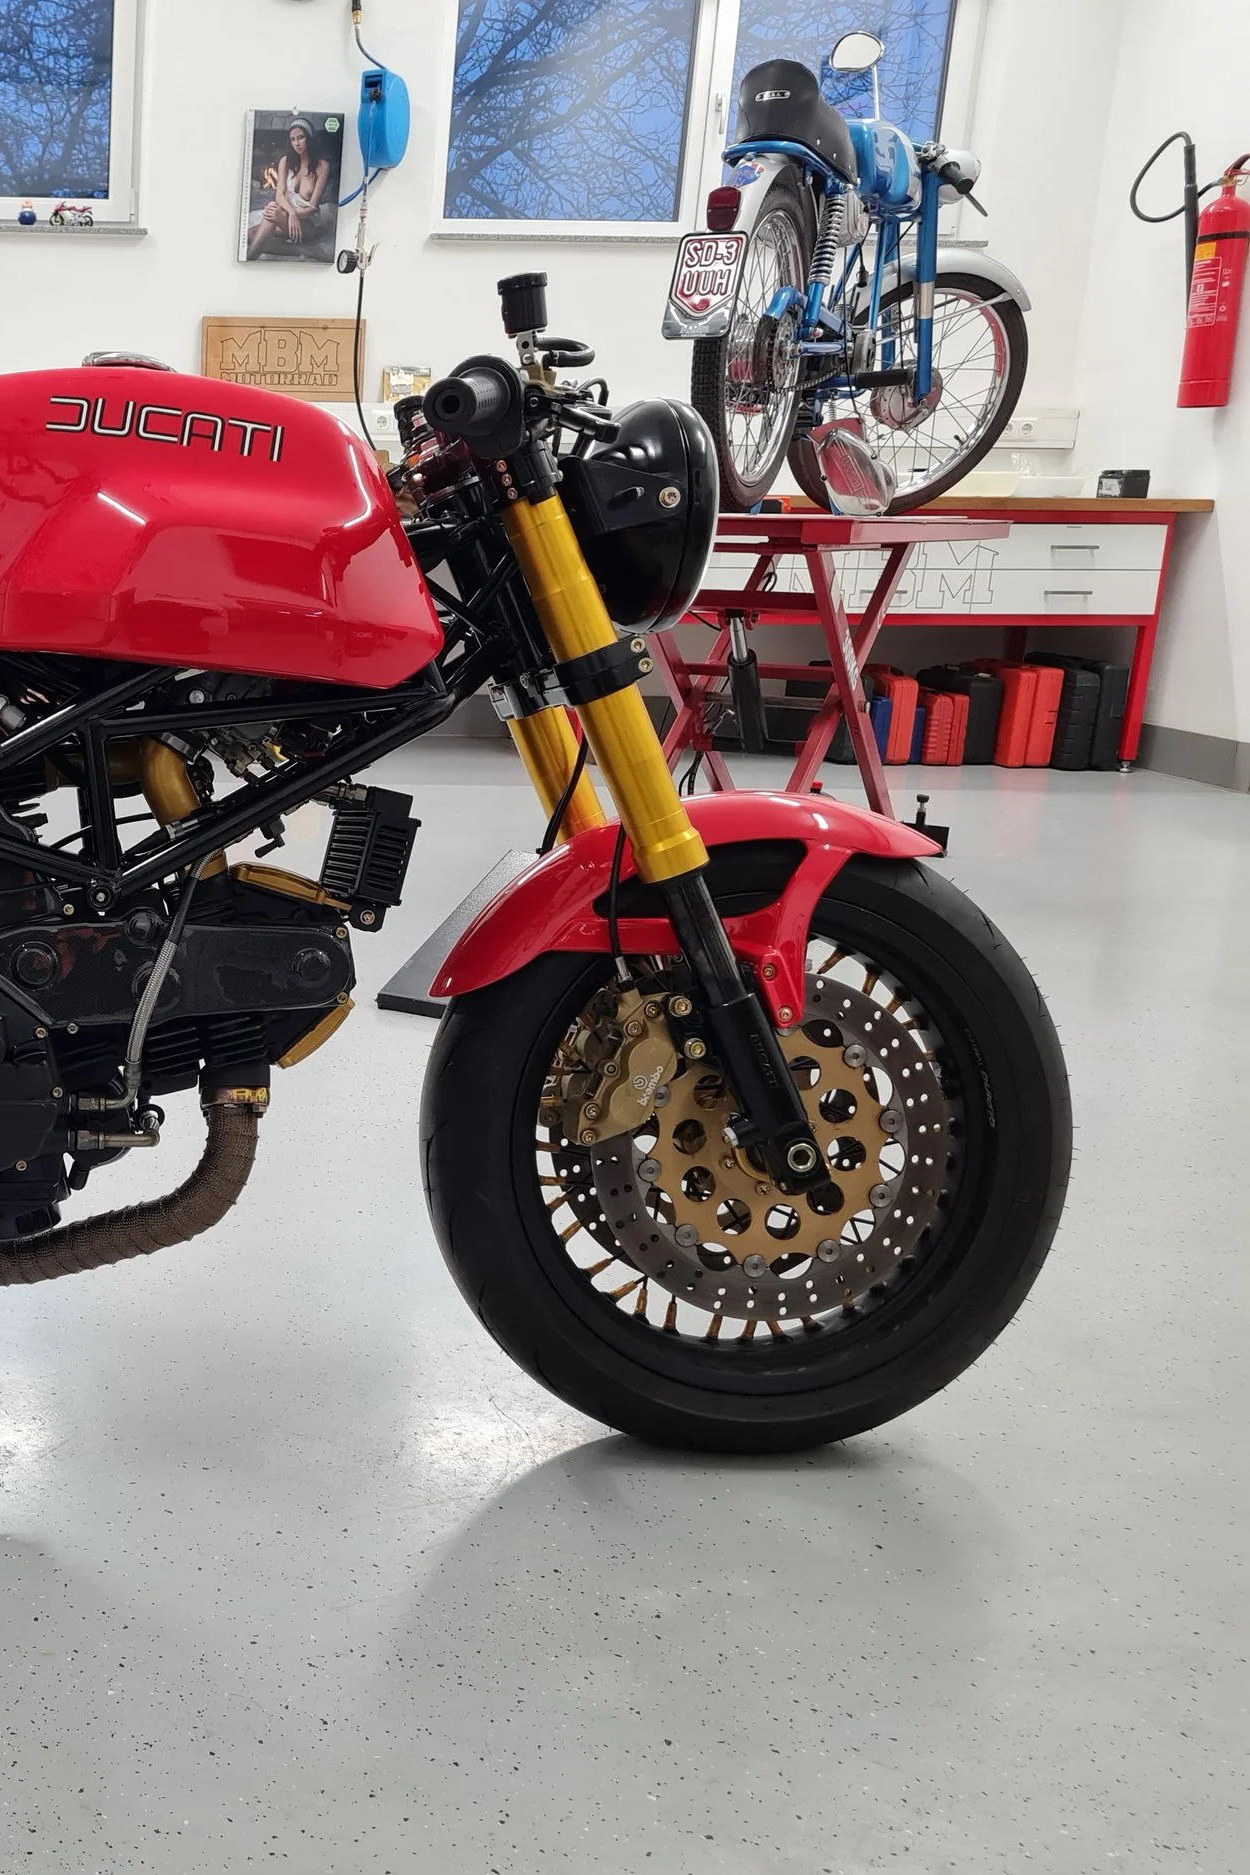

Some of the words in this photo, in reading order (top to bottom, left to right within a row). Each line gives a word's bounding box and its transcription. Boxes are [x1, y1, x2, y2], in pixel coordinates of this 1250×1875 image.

[680, 268, 732, 296] UUH
[219, 329, 341, 372] MBM
[220, 371, 338, 387] MOTORRAD
[46, 396, 285, 462] DUCATI
[636, 1065, 664, 1107] brembo
